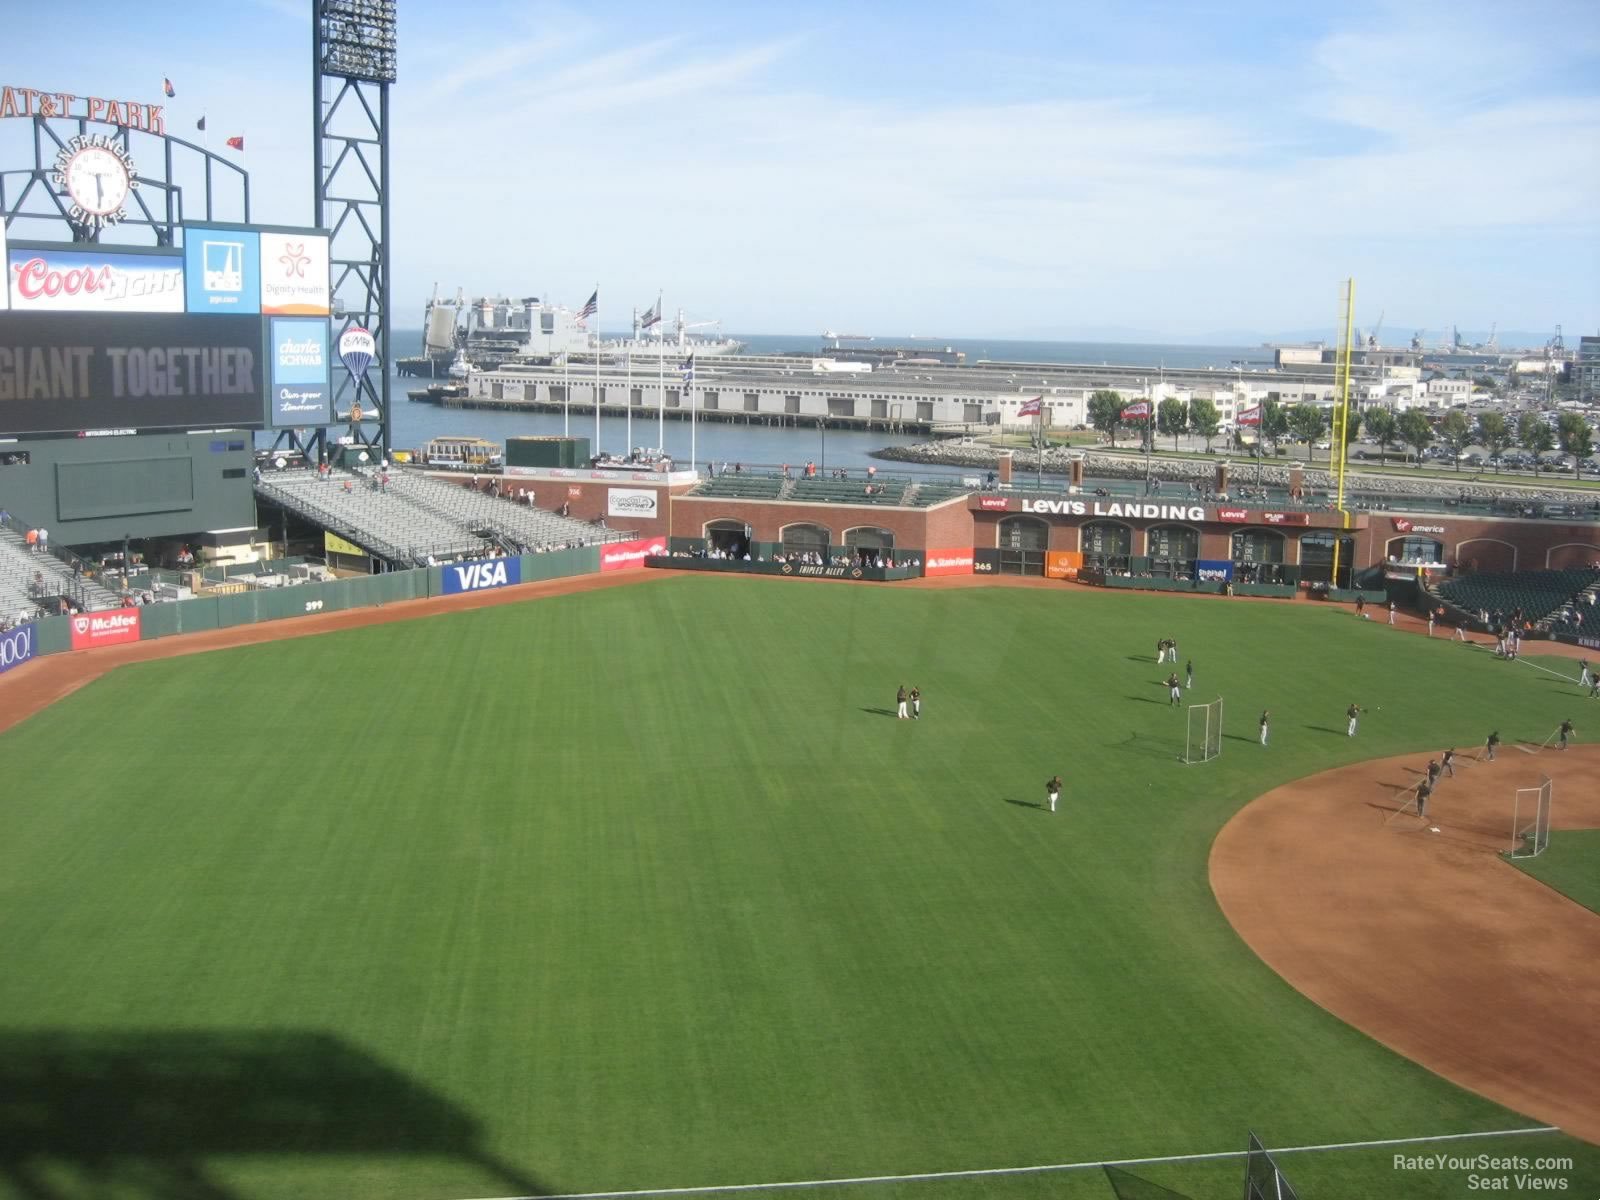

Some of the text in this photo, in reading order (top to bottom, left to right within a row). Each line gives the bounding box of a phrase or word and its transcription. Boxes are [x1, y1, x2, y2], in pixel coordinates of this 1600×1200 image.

[1, 86, 164, 136] AT&T PARK
[53, 133, 140, 189] SAN FRANCISCO
[69, 203, 128, 228] GIANTS
[14, 258, 112, 299] Coors
[266, 284, 326, 295] Dignity Health
[280, 338, 322, 354] charles
[280, 354, 322, 366] SCHWAB
[0, 345, 255, 400] GIANT TOGETHER
[610, 495, 641, 505] Comcast
[982, 499, 1006, 507] Levi's
[1022, 499, 1205, 520] Levi's LANDING
[1221, 510, 1246, 519] Levi's
[1411, 525, 1445, 533] america
[799, 565, 845, 576] TRIPLES ALLEY
[975, 562, 992, 571] 365
[453, 561, 508, 590] VISA
[305, 600, 323, 611] 399
[92, 615, 137, 631] McAfee
